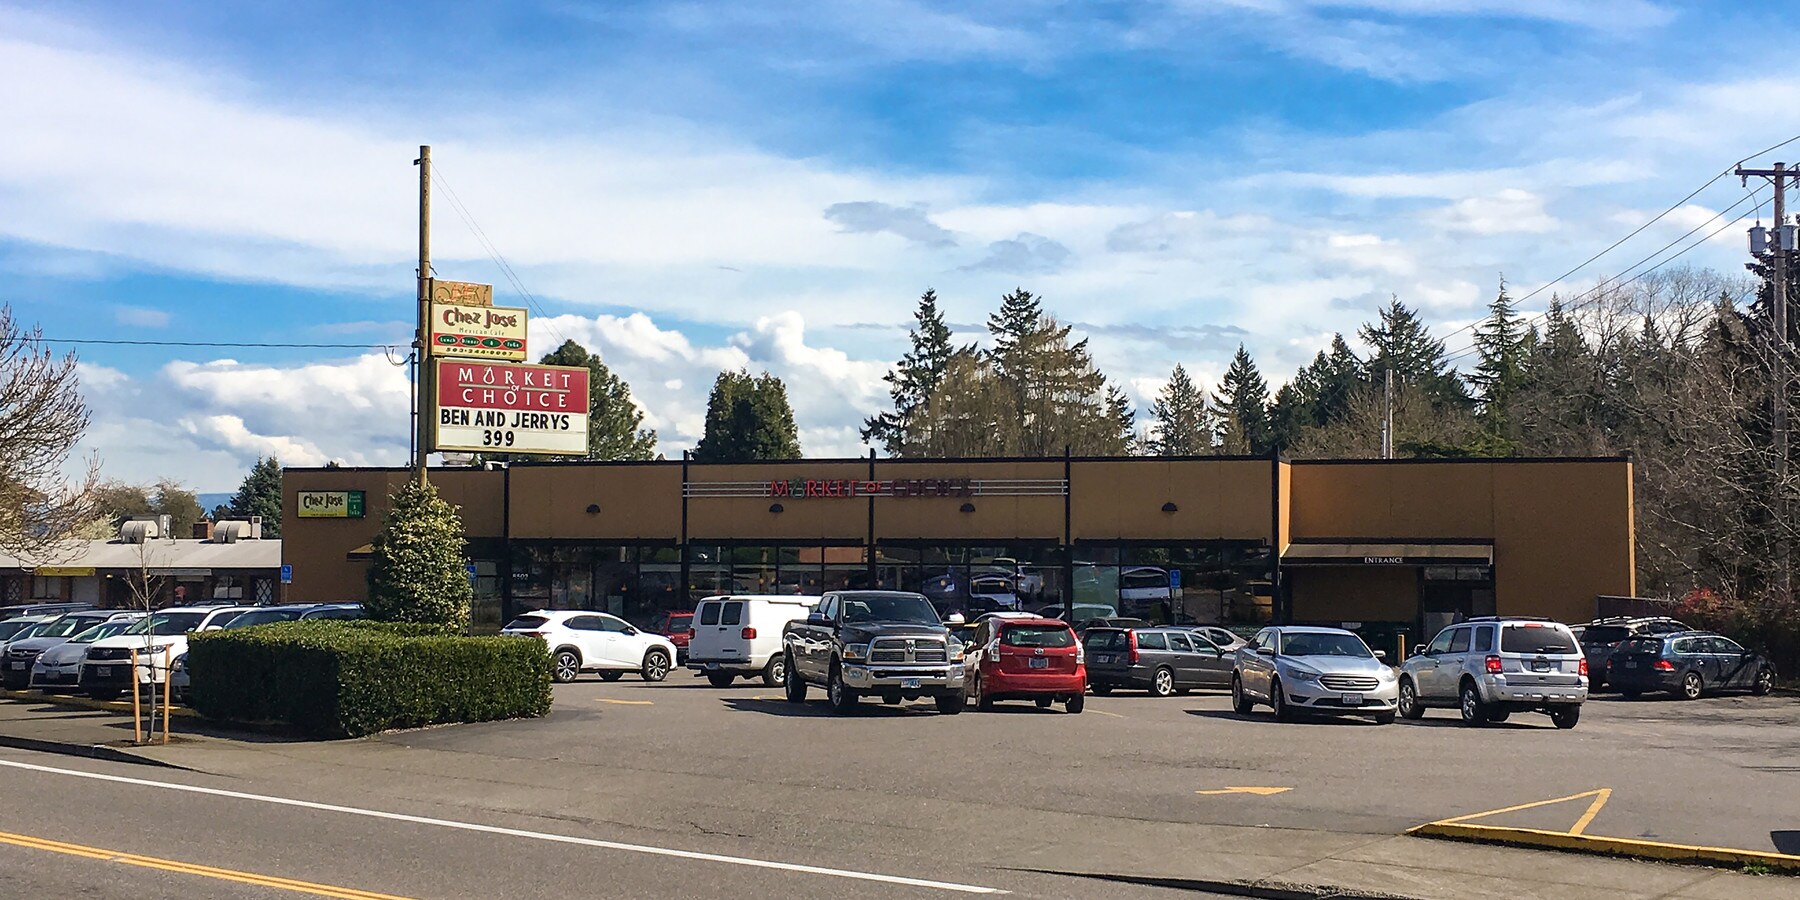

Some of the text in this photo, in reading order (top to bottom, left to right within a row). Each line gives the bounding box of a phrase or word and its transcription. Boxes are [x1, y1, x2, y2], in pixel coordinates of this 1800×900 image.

[443, 307, 481, 326] Chez
[462, 388, 567, 407] CHOICE
[441, 408, 570, 430] BEN AND JERRYS
[483, 429, 514, 447] 399
[303, 493, 323, 509] Chez
